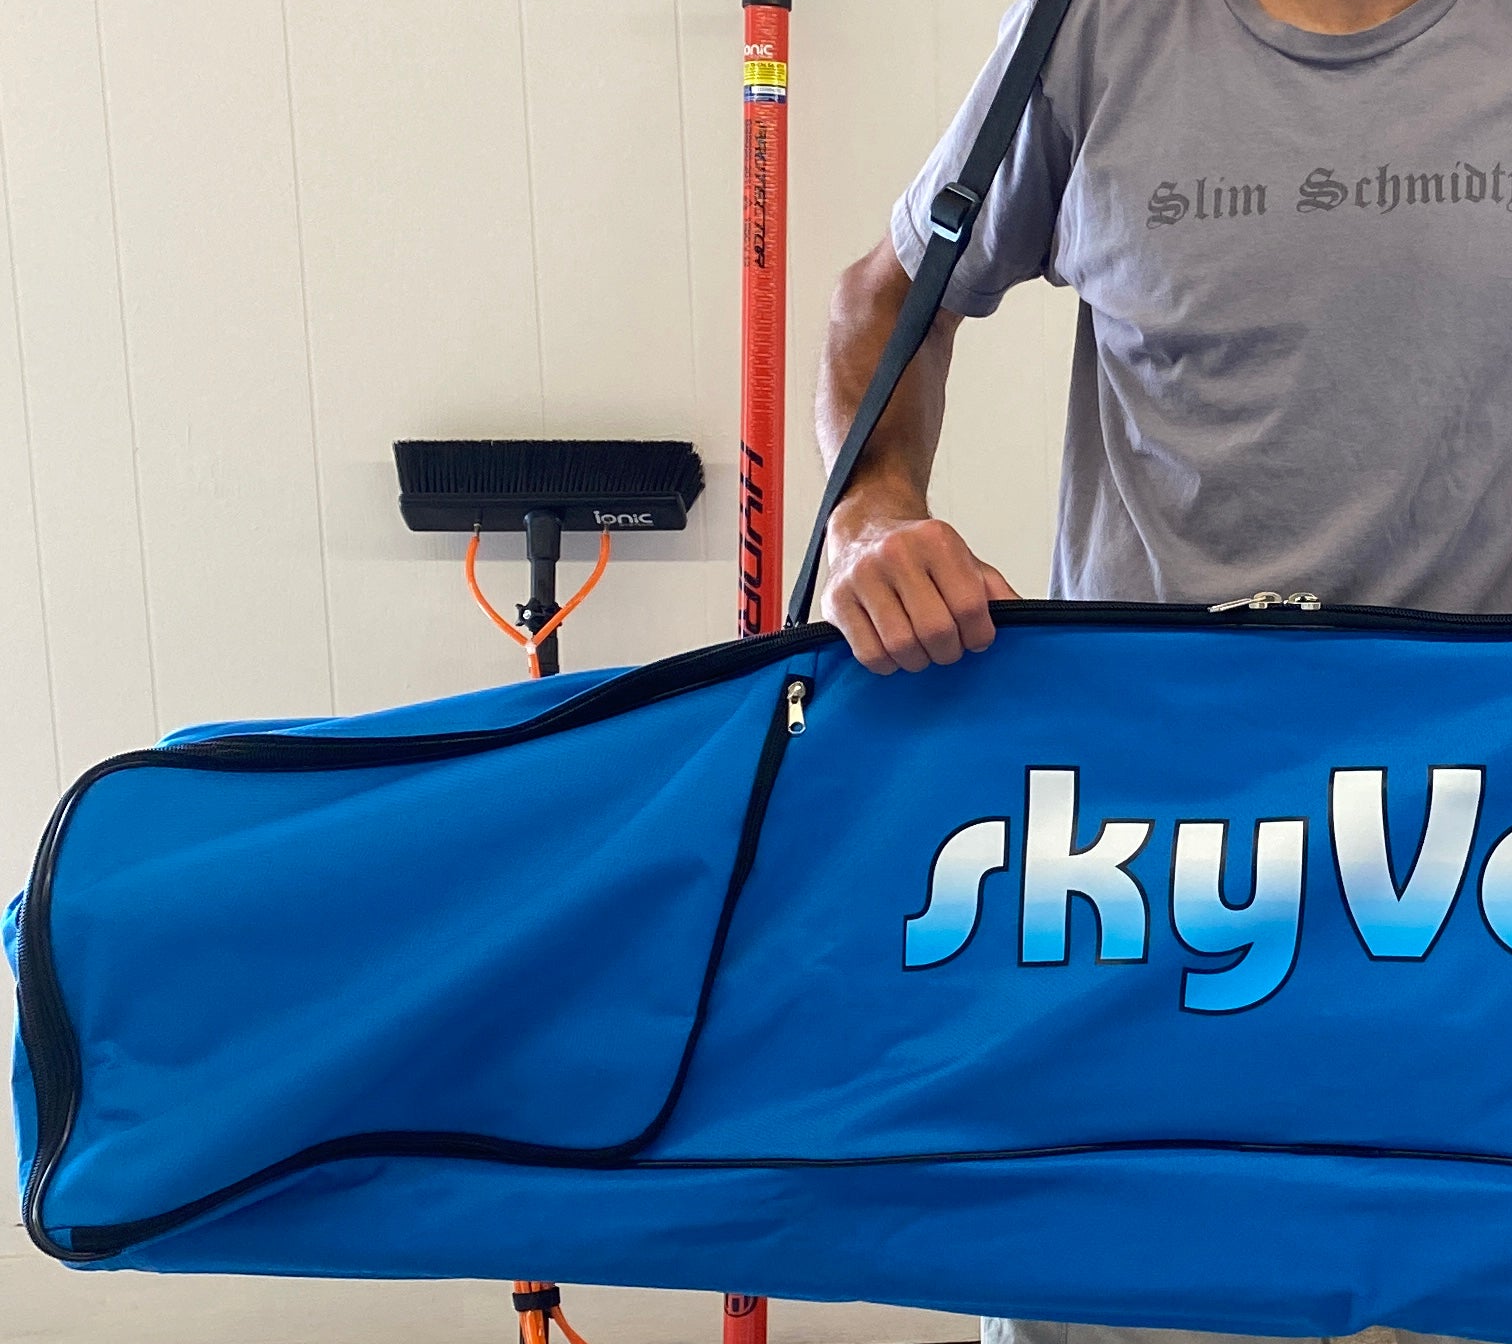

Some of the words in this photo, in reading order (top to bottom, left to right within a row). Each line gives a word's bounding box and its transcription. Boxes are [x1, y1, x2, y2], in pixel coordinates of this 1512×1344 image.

[743, 43, 774, 57] onic
[1145, 176, 1268, 230] Slim
[592, 510, 654, 525] ionic
[739, 439, 764, 639] HYDR
